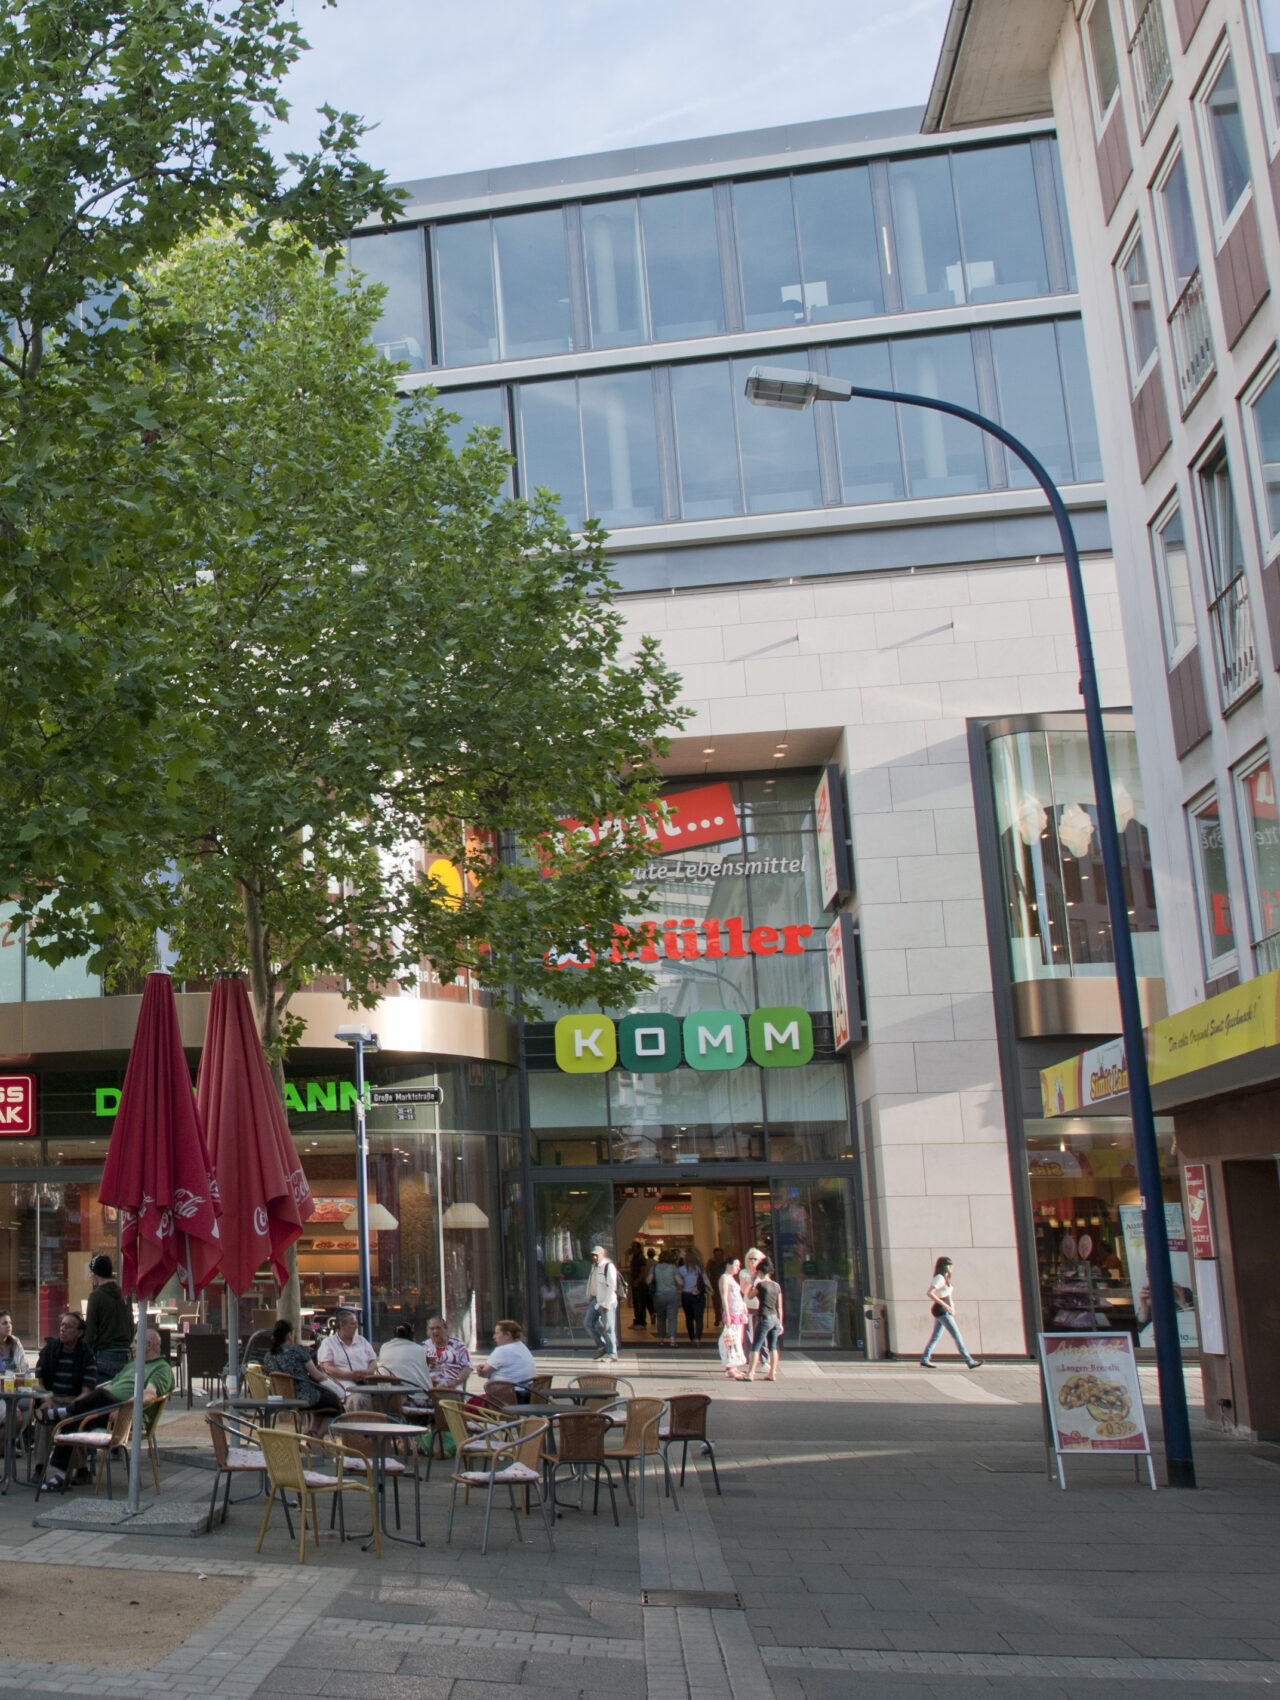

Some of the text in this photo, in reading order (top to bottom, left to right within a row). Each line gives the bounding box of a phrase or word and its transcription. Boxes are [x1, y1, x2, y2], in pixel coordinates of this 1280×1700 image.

[675, 854, 808, 880] Lebensmittel
[609, 916, 814, 963] Müller
[573, 1020, 800, 1058] KOMM
[373, 1092, 435, 1103] Große Marktstraße
[1089, 1064, 1129, 1101] Simit Lan
